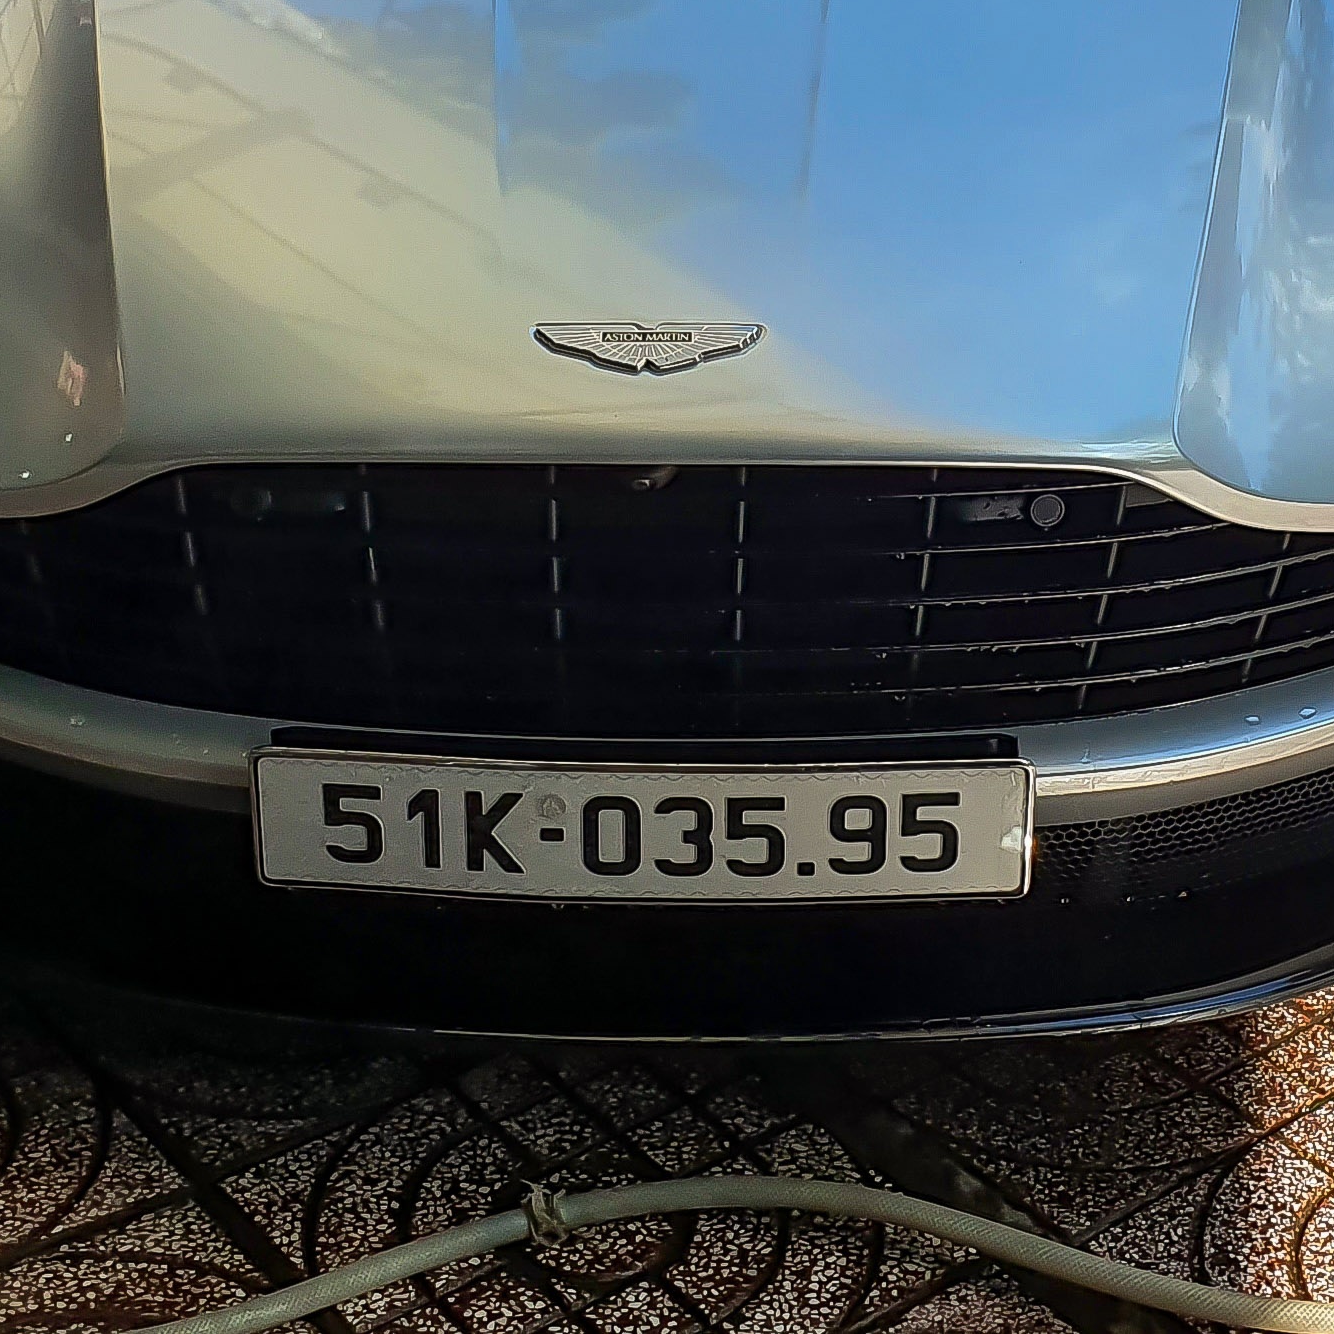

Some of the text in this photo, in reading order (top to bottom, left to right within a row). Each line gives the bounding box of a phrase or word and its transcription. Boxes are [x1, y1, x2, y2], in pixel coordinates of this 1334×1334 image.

[604, 332, 690, 342] ASTON MARTIN
[322, 782, 961, 876] 51K-035.95
